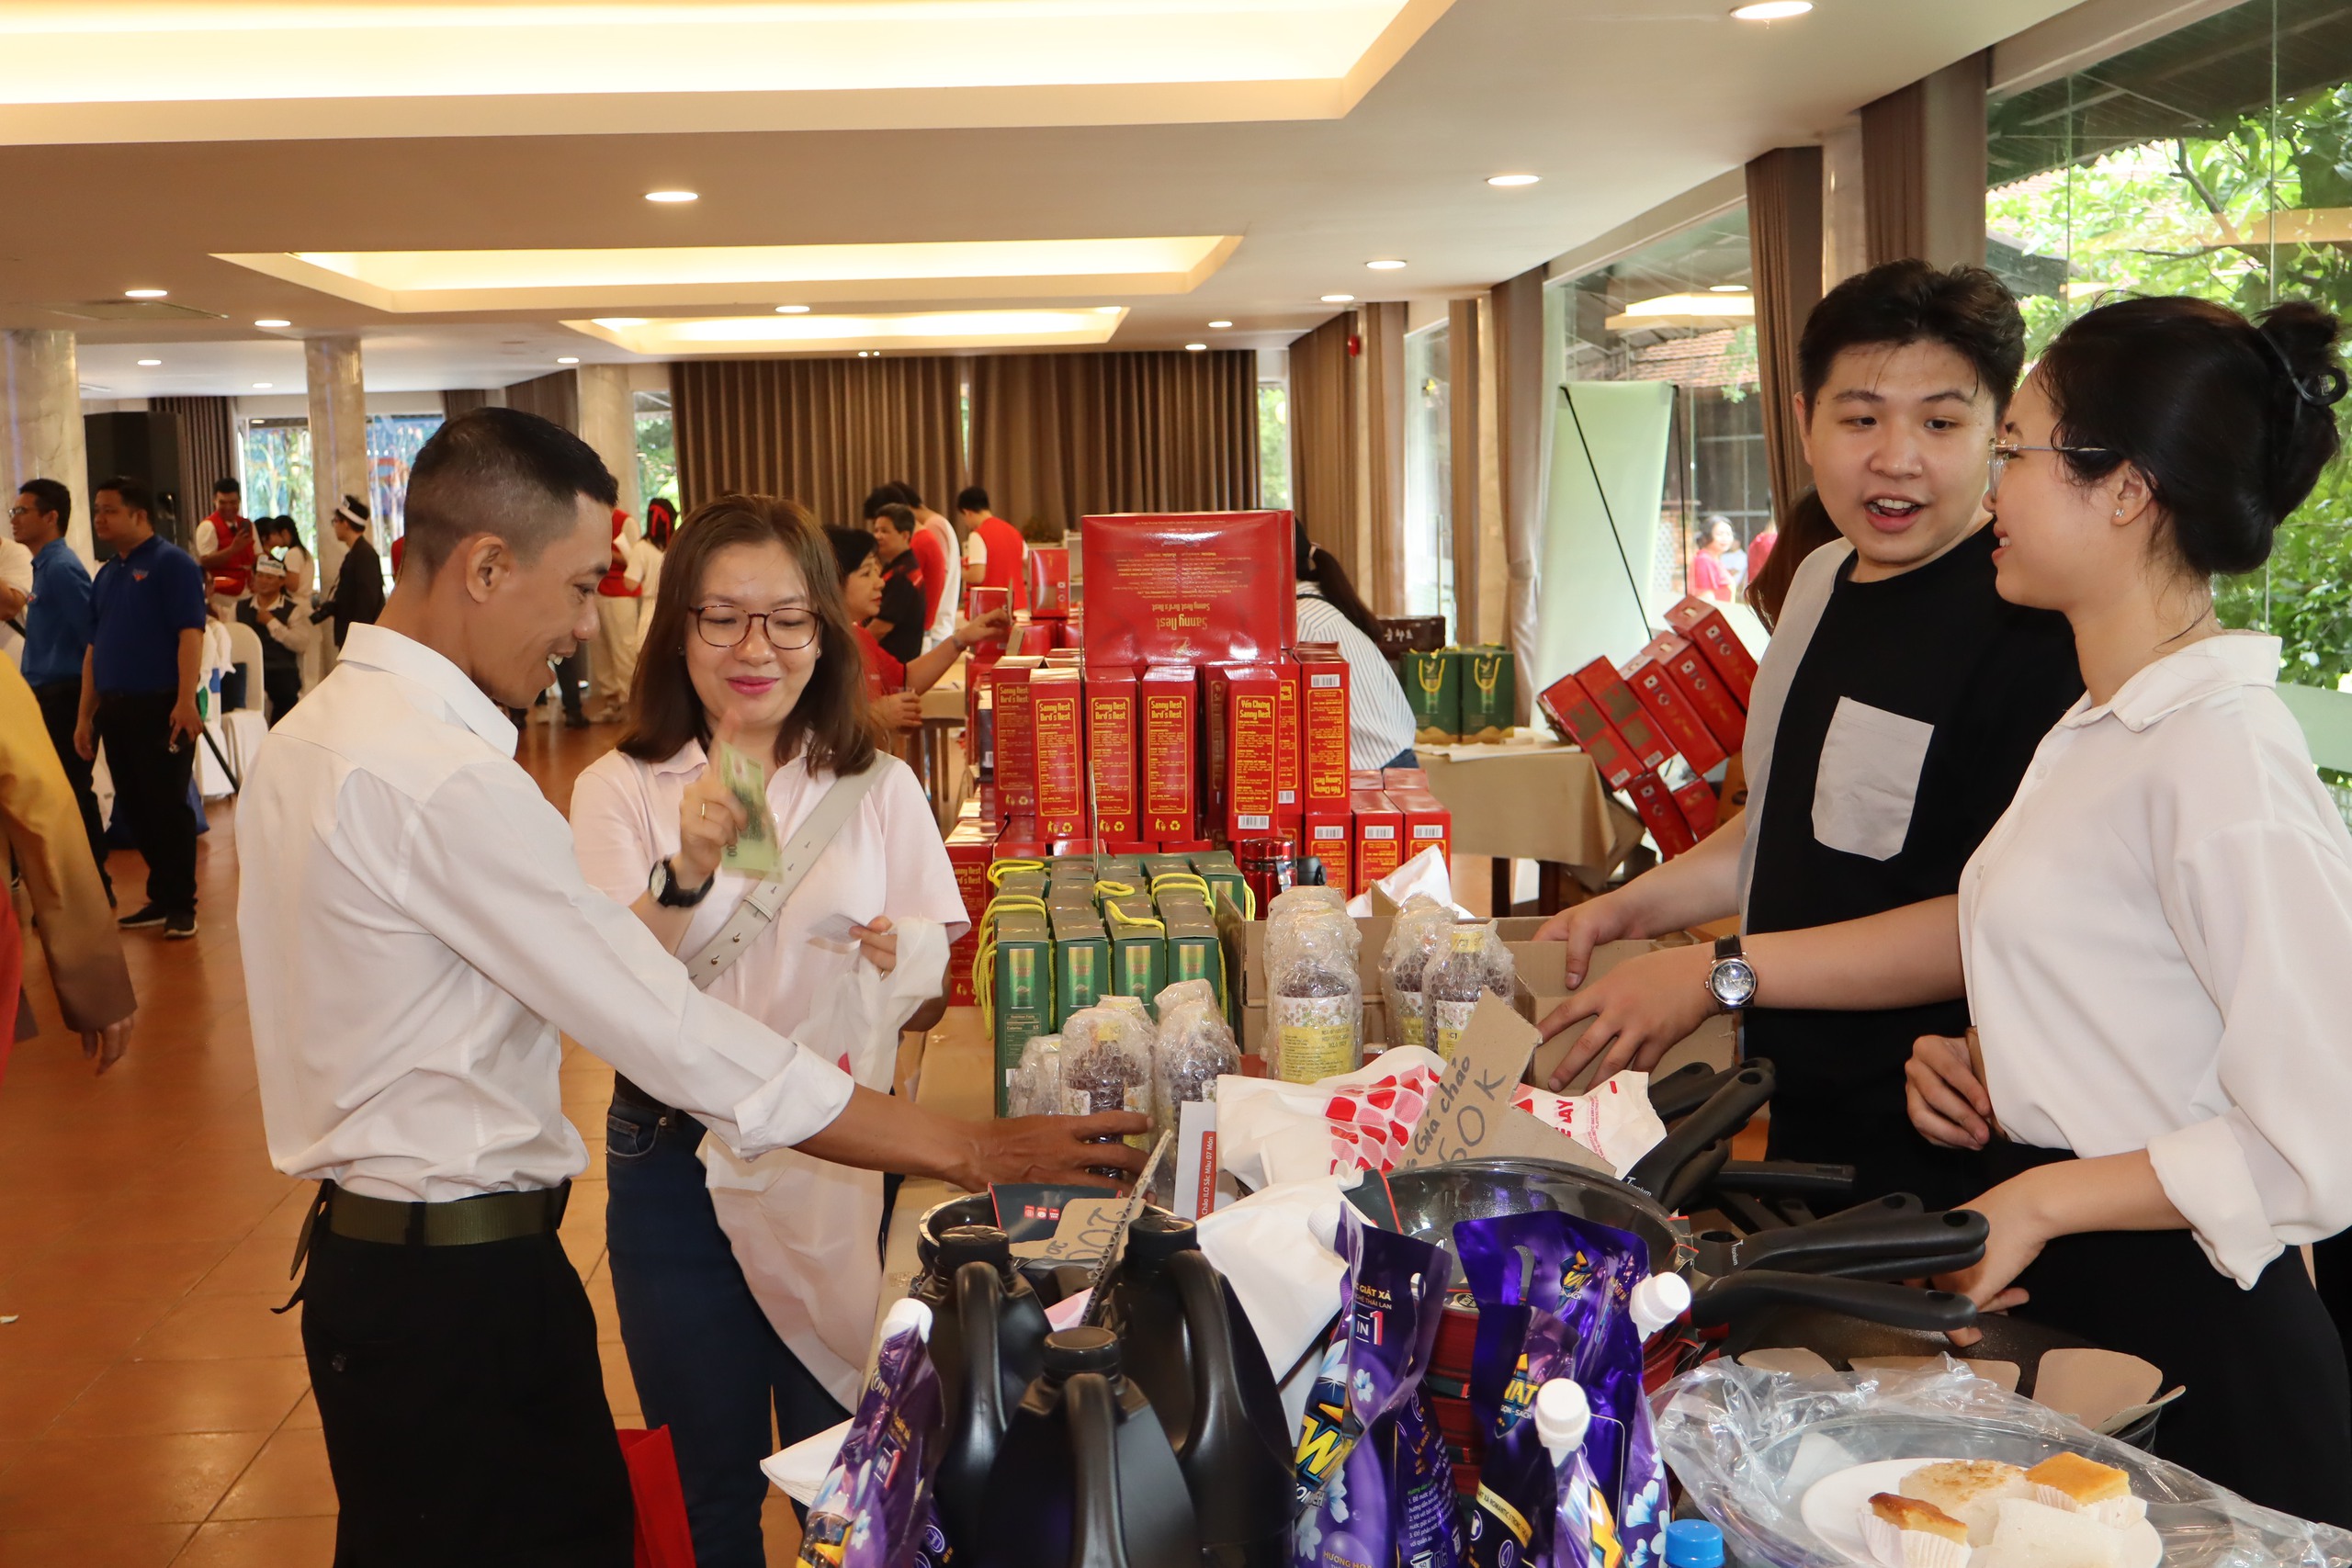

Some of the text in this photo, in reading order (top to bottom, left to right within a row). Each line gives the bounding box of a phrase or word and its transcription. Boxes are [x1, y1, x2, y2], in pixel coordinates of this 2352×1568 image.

[1156, 614, 1208, 631] Sanny Nest
[1040, 703, 1071, 713] Sanny Nest
[1095, 702, 1126, 712] Sanny Nest
[1151, 700, 1182, 711] Sanny Nest
[1113, 711, 1126, 720] Nest
[1169, 710, 1182, 718] Nest
[1240, 709, 1272, 720] Sanny Nest
[1325, 775, 1341, 784] Sanny
[1440, 1056, 1470, 1113] chảo
[1356, 1310, 1384, 1346] IN 1
[1504, 1378, 1540, 1405] AT
[1490, 1499, 1510, 1520] ROMANTIC
